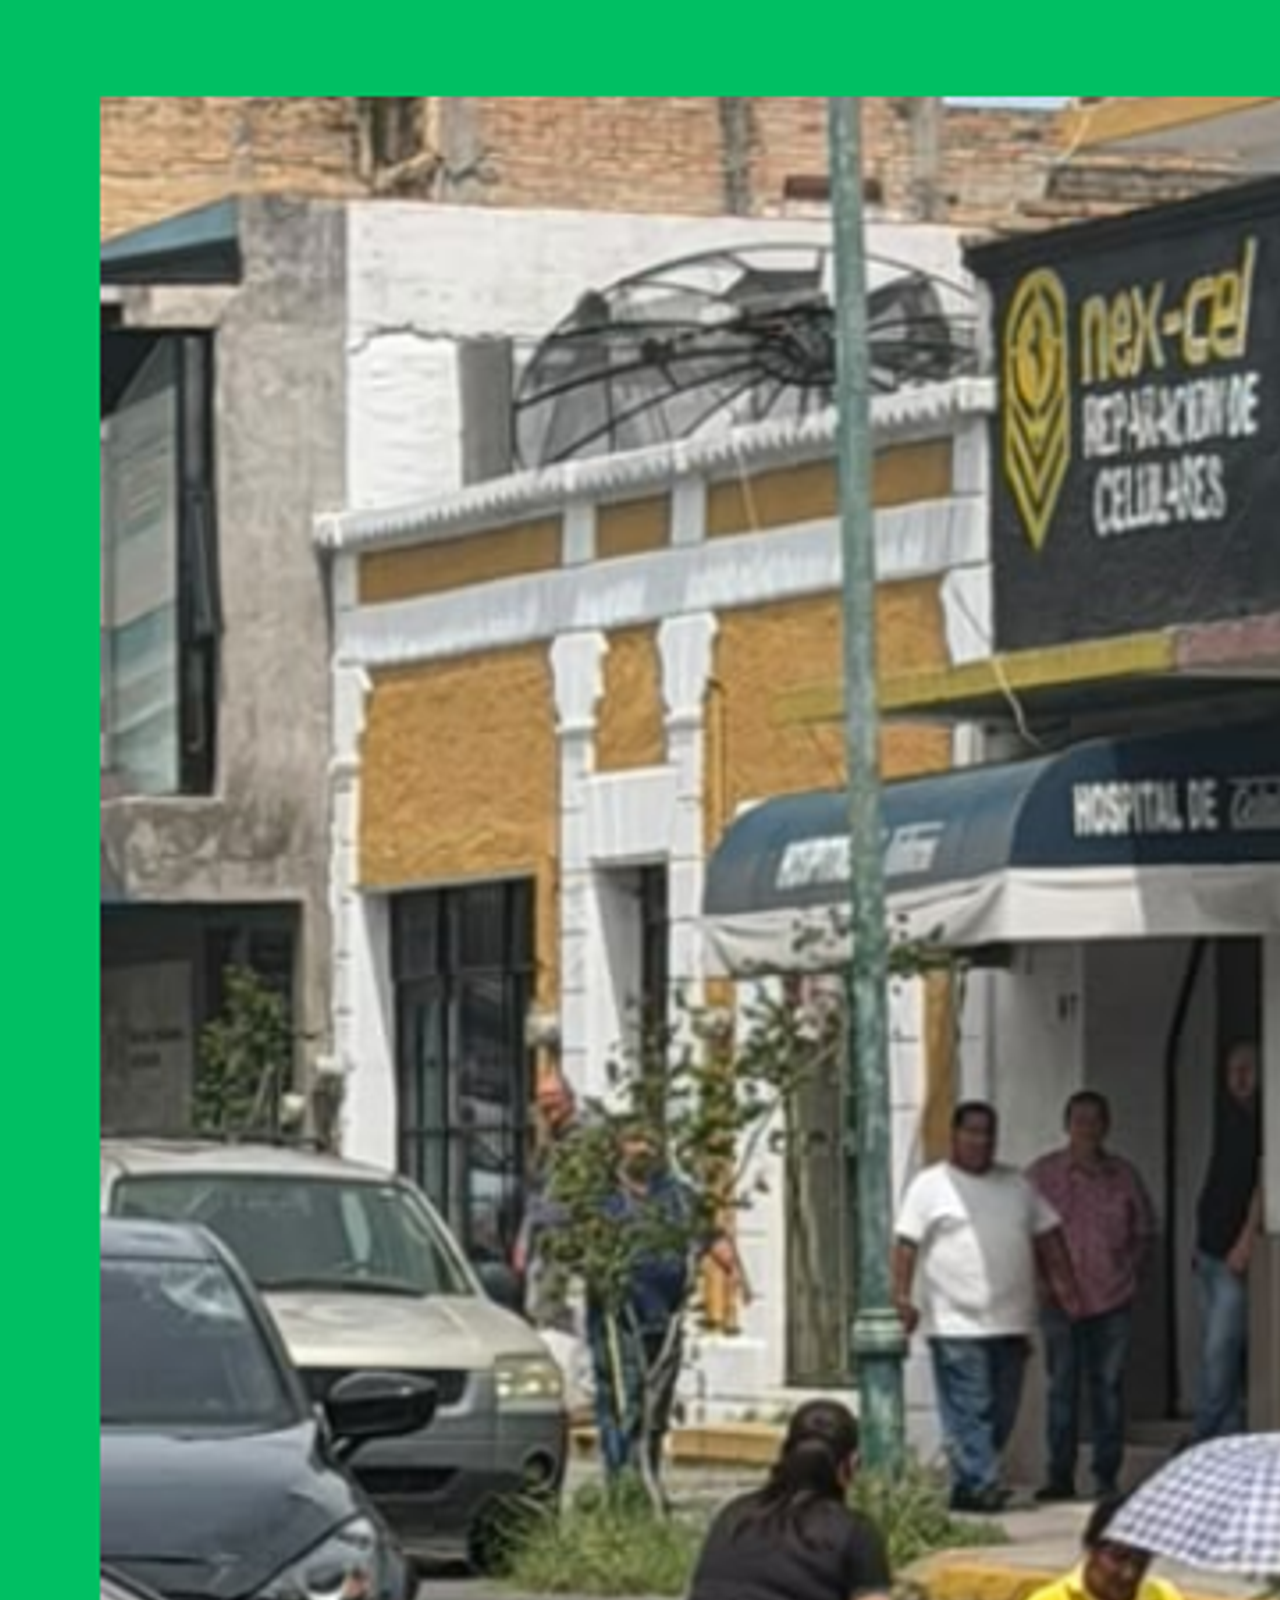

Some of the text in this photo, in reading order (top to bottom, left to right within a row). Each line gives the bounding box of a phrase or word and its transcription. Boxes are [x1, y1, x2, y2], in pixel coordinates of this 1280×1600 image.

[1080, 236, 1258, 383] nex-cel
[1228, 372, 1260, 438] DE
[1094, 454, 1227, 536] CELULARES
[1073, 783, 1184, 836] HOSPITAL
[1187, 778, 1218, 830] DE
